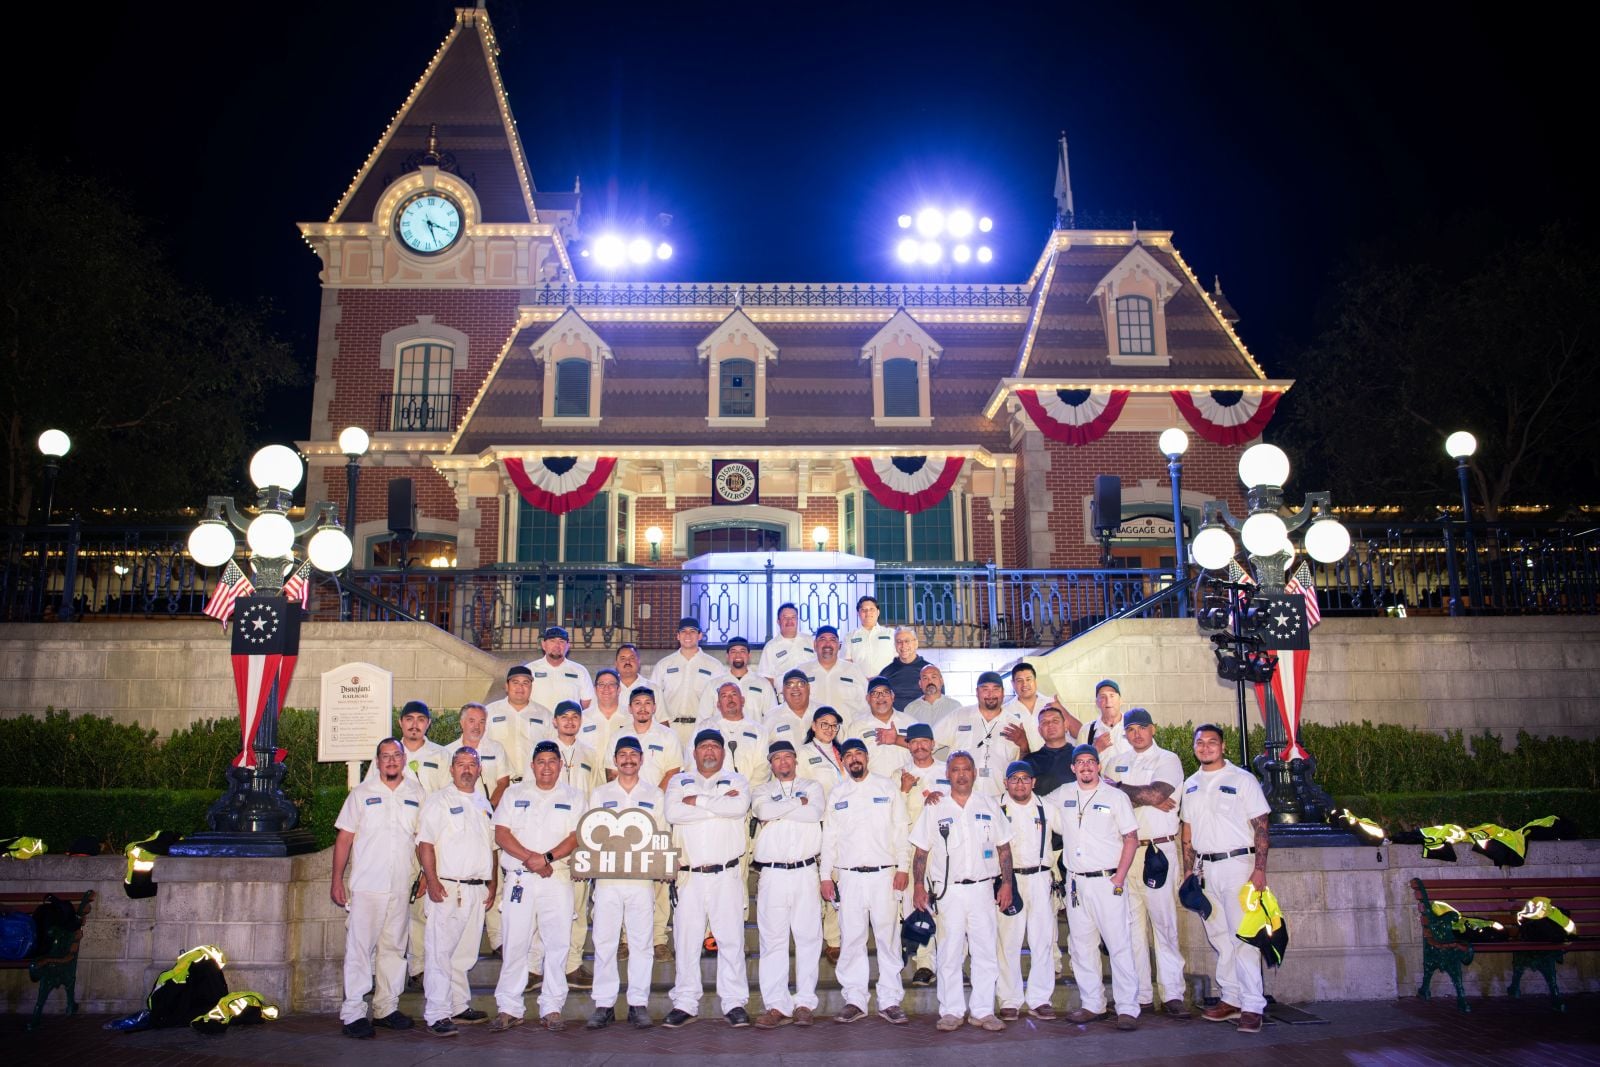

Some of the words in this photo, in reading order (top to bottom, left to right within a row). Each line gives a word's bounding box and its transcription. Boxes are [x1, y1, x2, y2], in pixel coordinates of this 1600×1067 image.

[718, 465, 754, 481] Disneyland
[719, 486, 752, 499] RAILROAD
[1159, 526, 1176, 534] CLAI
[340, 684, 371, 693] Disneyland
[574, 850, 677, 873] SHIFT
